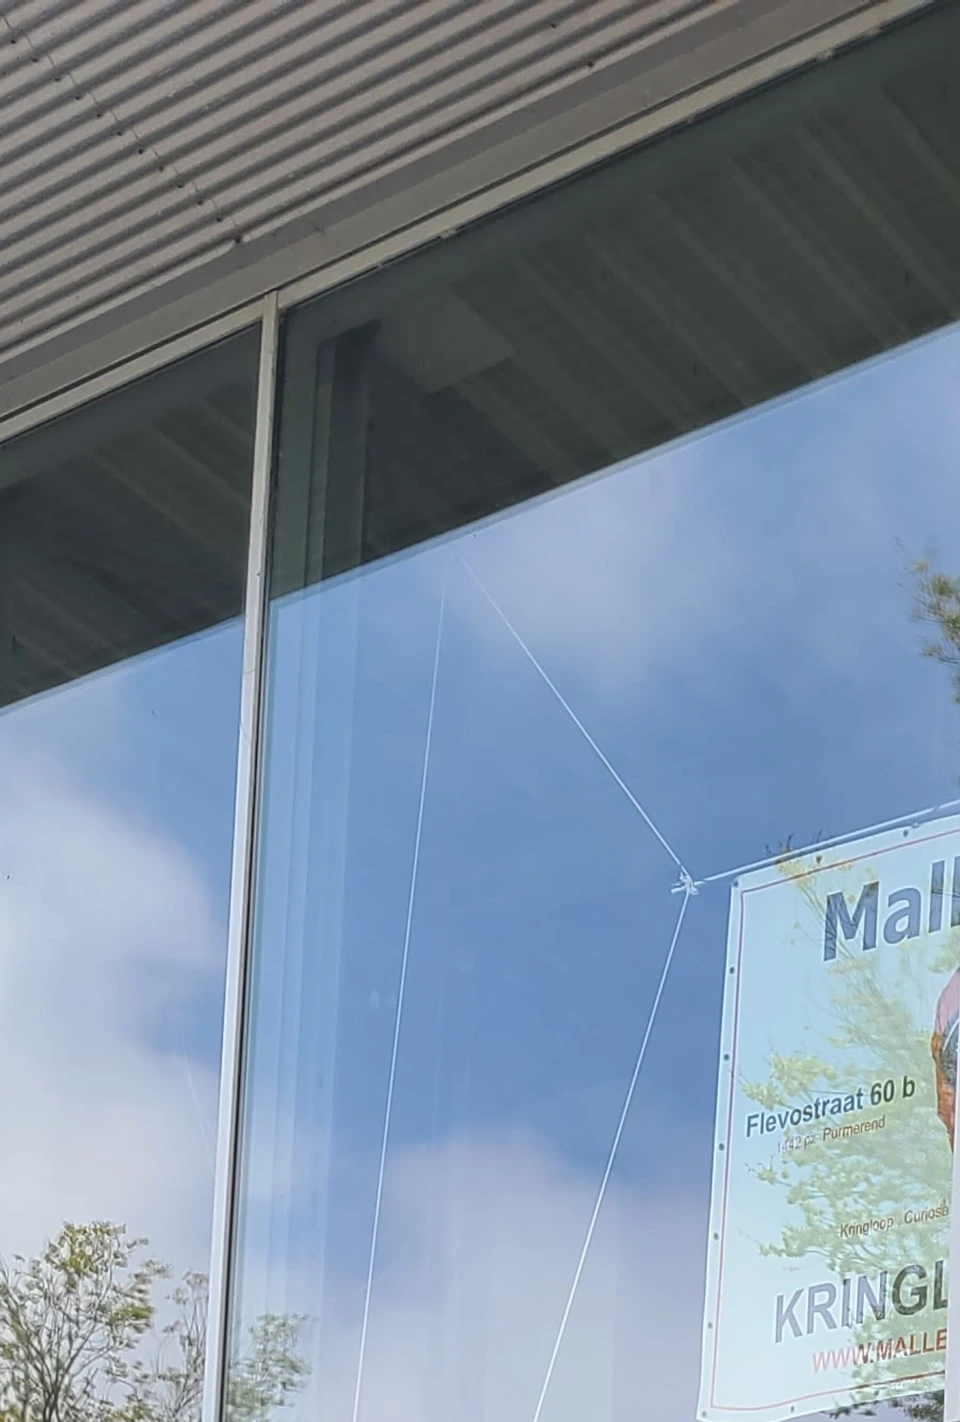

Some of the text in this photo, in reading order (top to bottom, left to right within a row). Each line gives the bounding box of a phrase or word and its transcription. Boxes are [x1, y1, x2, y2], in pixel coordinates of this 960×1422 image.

[746, 1075, 916, 1138] Flevostraat 60 b
[822, 1115, 887, 1142] Purmerend
